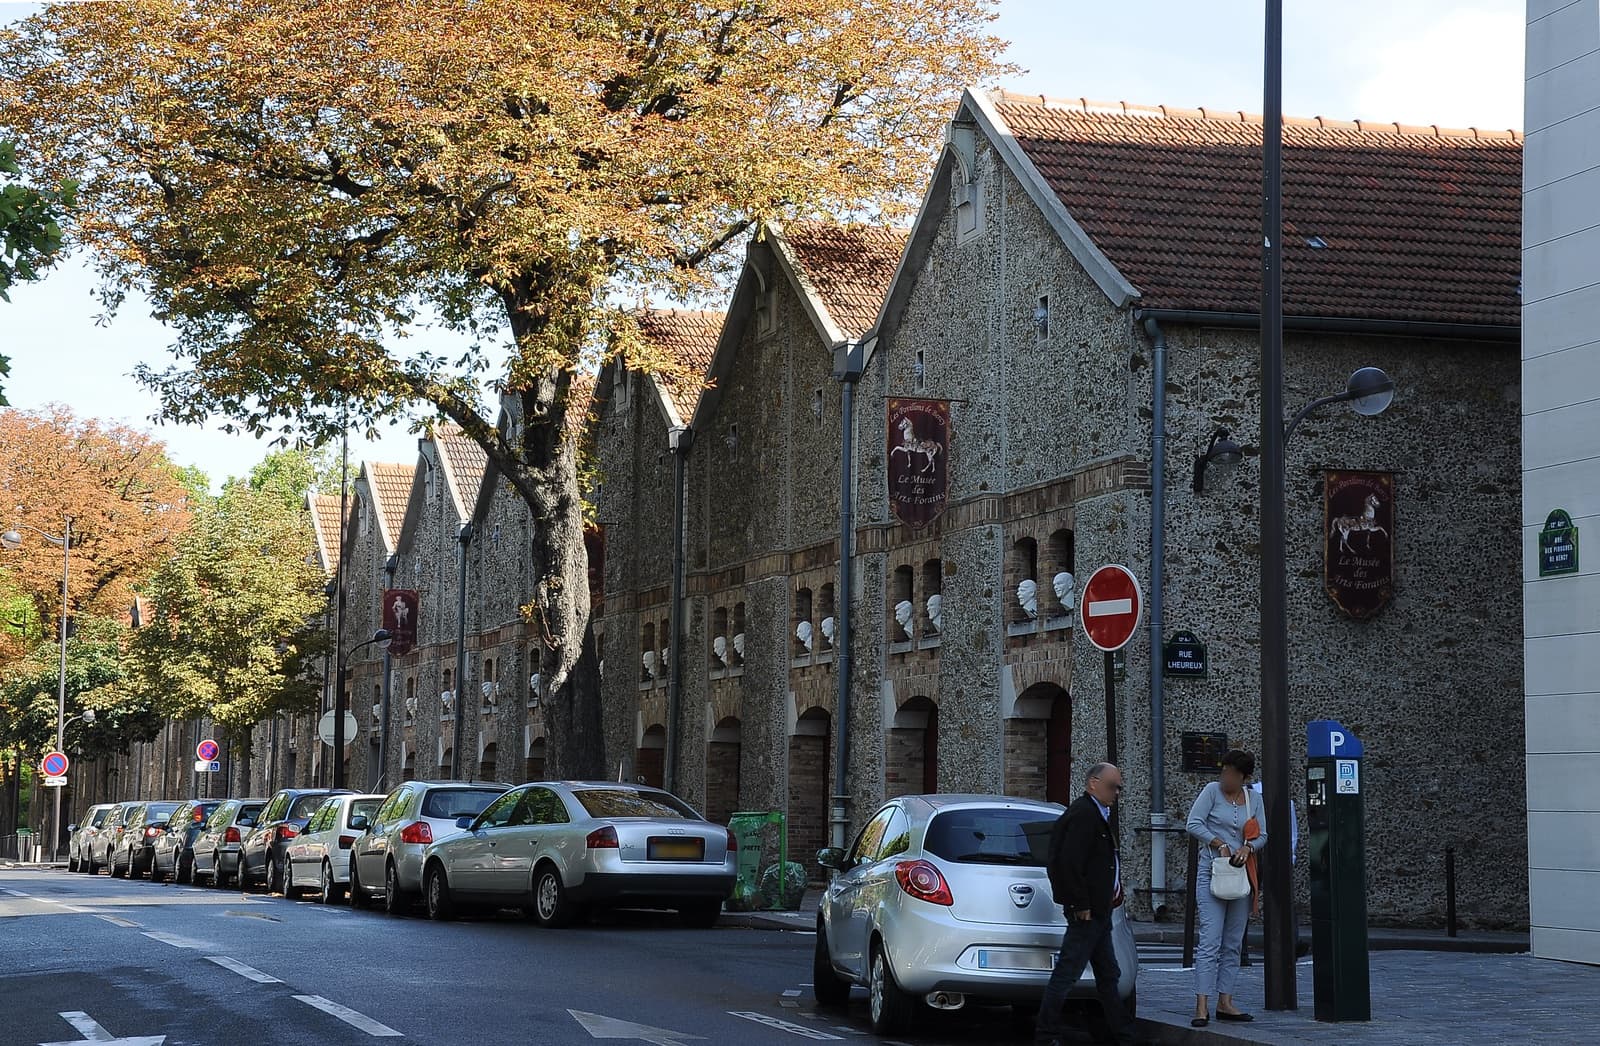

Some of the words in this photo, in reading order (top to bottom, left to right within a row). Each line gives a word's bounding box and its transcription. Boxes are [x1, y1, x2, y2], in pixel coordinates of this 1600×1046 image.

[890, 412, 900, 424] Les
[898, 474, 910, 484] Le
[911, 484, 926, 495] des
[913, 491, 946, 505] Forains
[1338, 555, 1351, 566] Le
[1353, 567, 1368, 578] des
[1355, 575, 1391, 590] Forains
[1179, 650, 1192, 658] RUE
[1168, 661, 1203, 669] LHEUREUX
[1330, 731, 1345, 756] P
